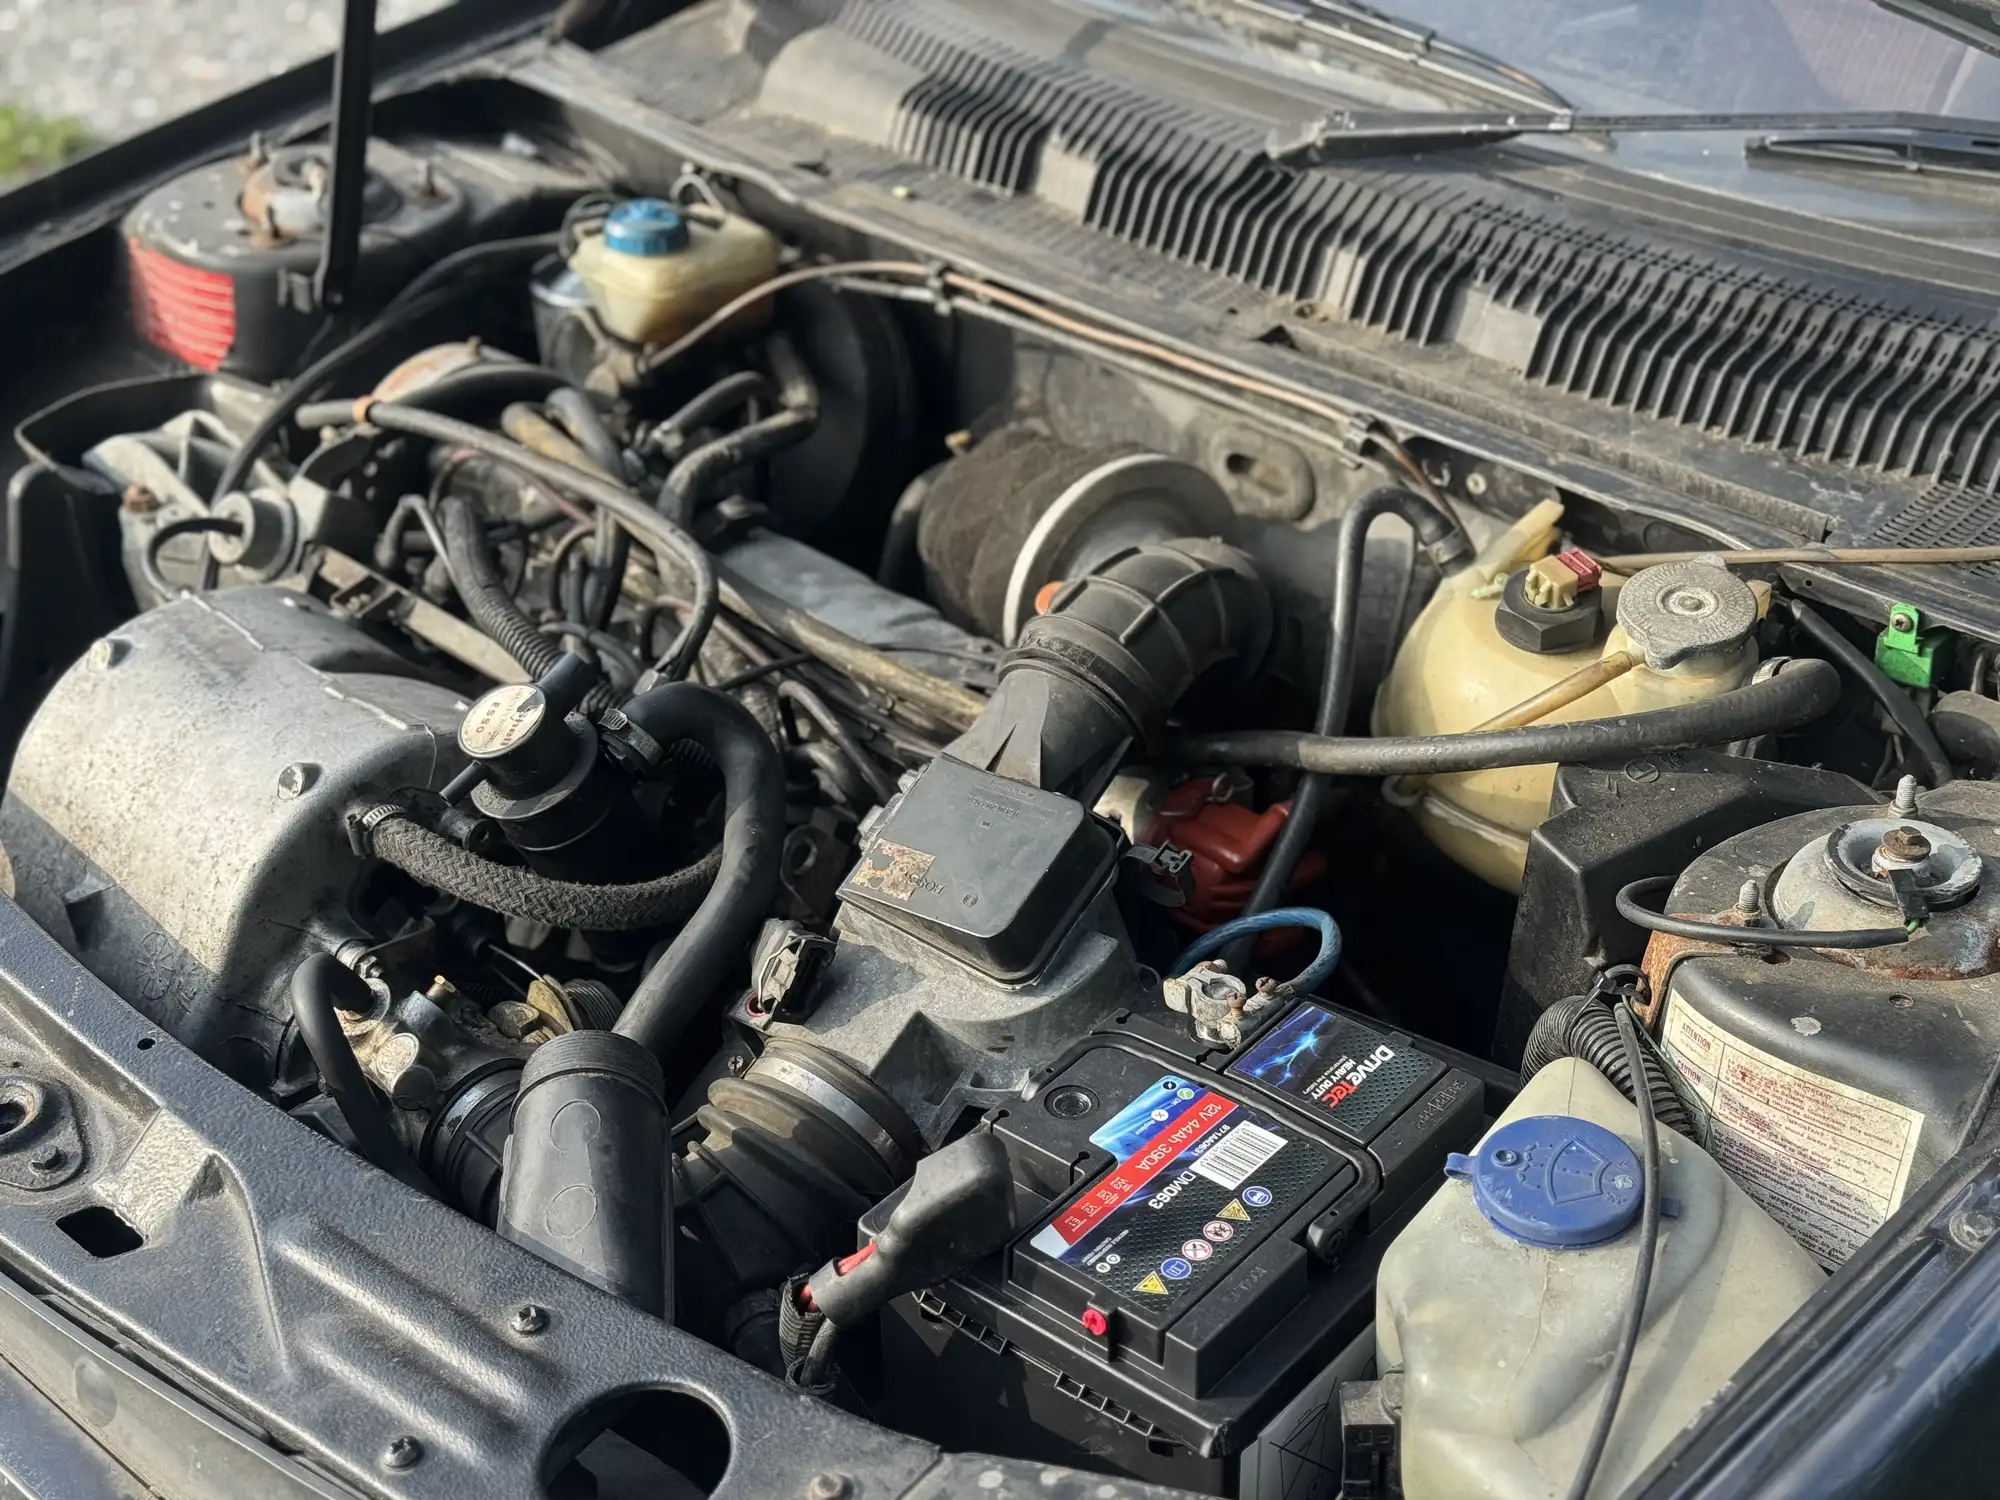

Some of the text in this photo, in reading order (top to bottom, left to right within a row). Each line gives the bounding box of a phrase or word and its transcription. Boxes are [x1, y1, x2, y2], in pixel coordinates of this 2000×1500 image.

[476, 702, 501, 733] ESSO
[1682, 1023, 1711, 1051] ATTENTION
[1311, 1058, 1356, 1100] HEAVY DUTY
[1677, 1059, 1701, 1083] CAUTION
[1198, 1103, 1222, 1122] 12V
[1167, 1119, 1201, 1144] 44Ah
[1135, 1143, 1173, 1171] 390A
[1148, 1170, 1197, 1210] DM063
